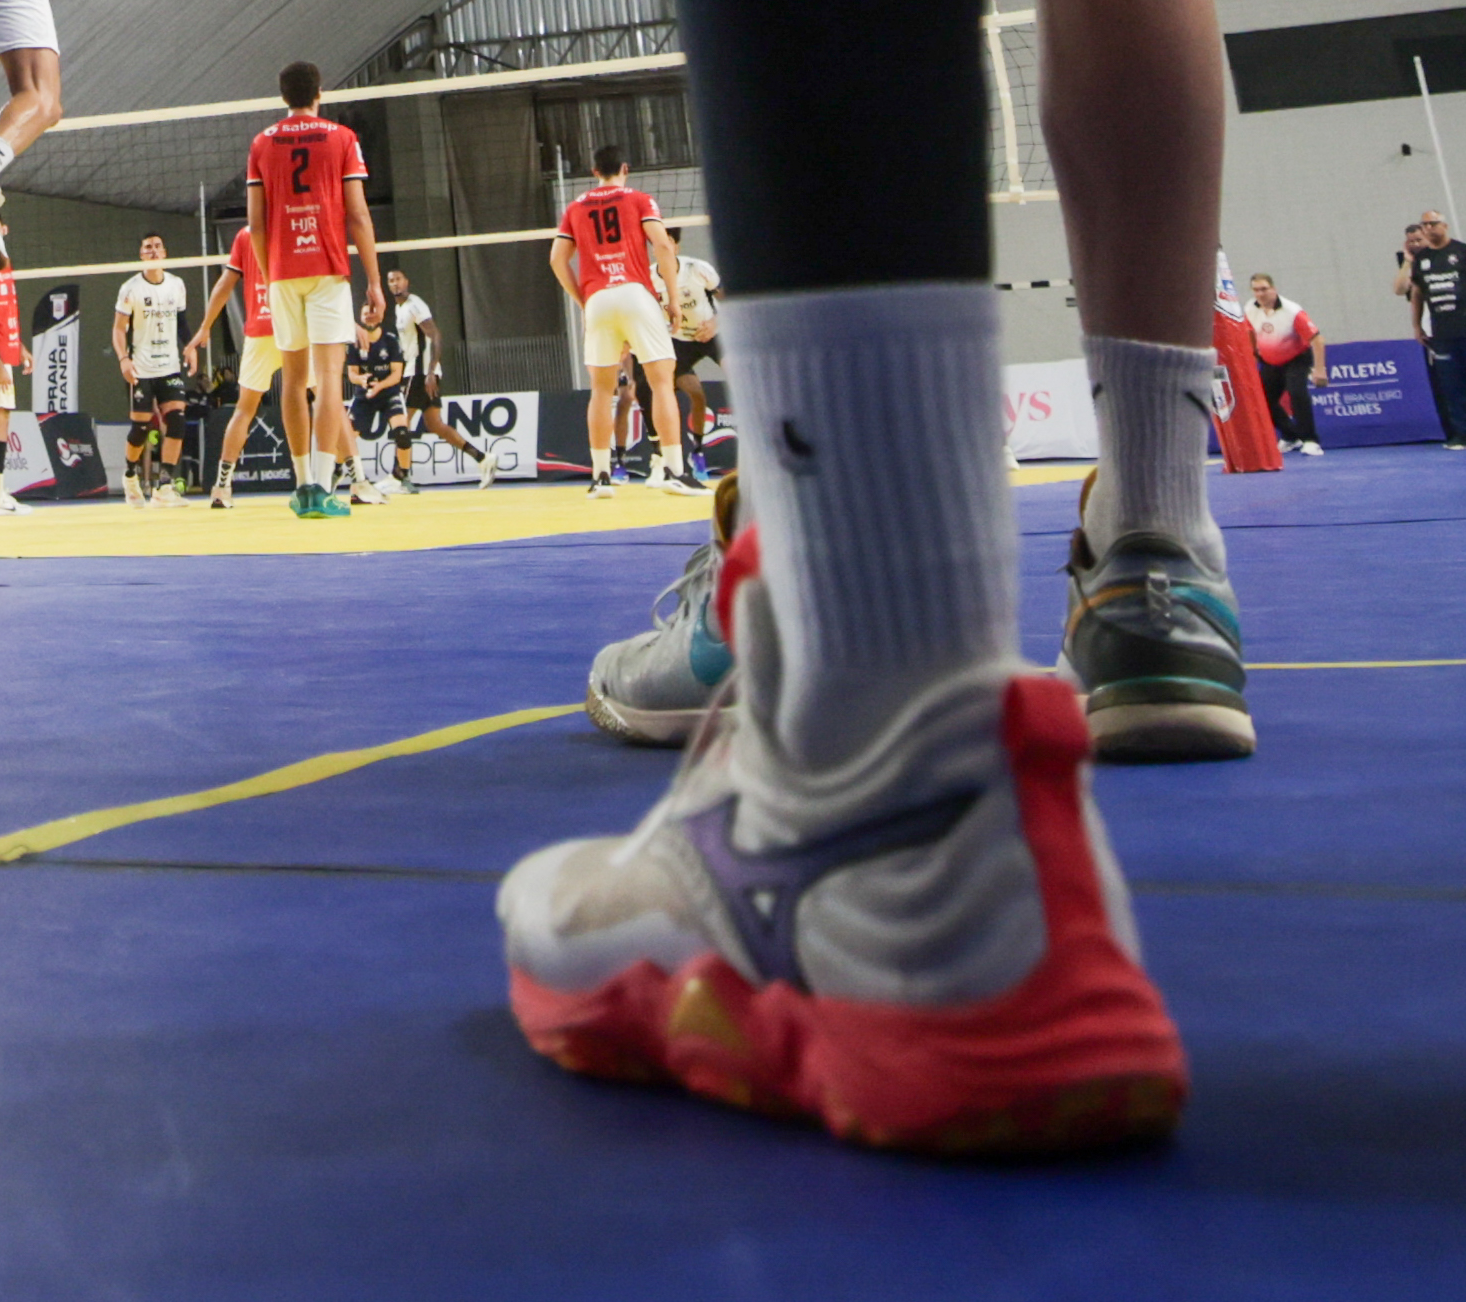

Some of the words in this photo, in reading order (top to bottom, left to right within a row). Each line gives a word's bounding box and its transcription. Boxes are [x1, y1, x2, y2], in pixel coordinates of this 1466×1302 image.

[281, 121, 339, 133] sabesp
[291, 147, 312, 194] 2
[290, 216, 318, 233] HJR
[588, 205, 622, 245] 19
[48, 348, 58, 413] PRAIA
[58, 334, 68, 414] RANDE
[1330, 360, 1398, 380] ATLETAS
